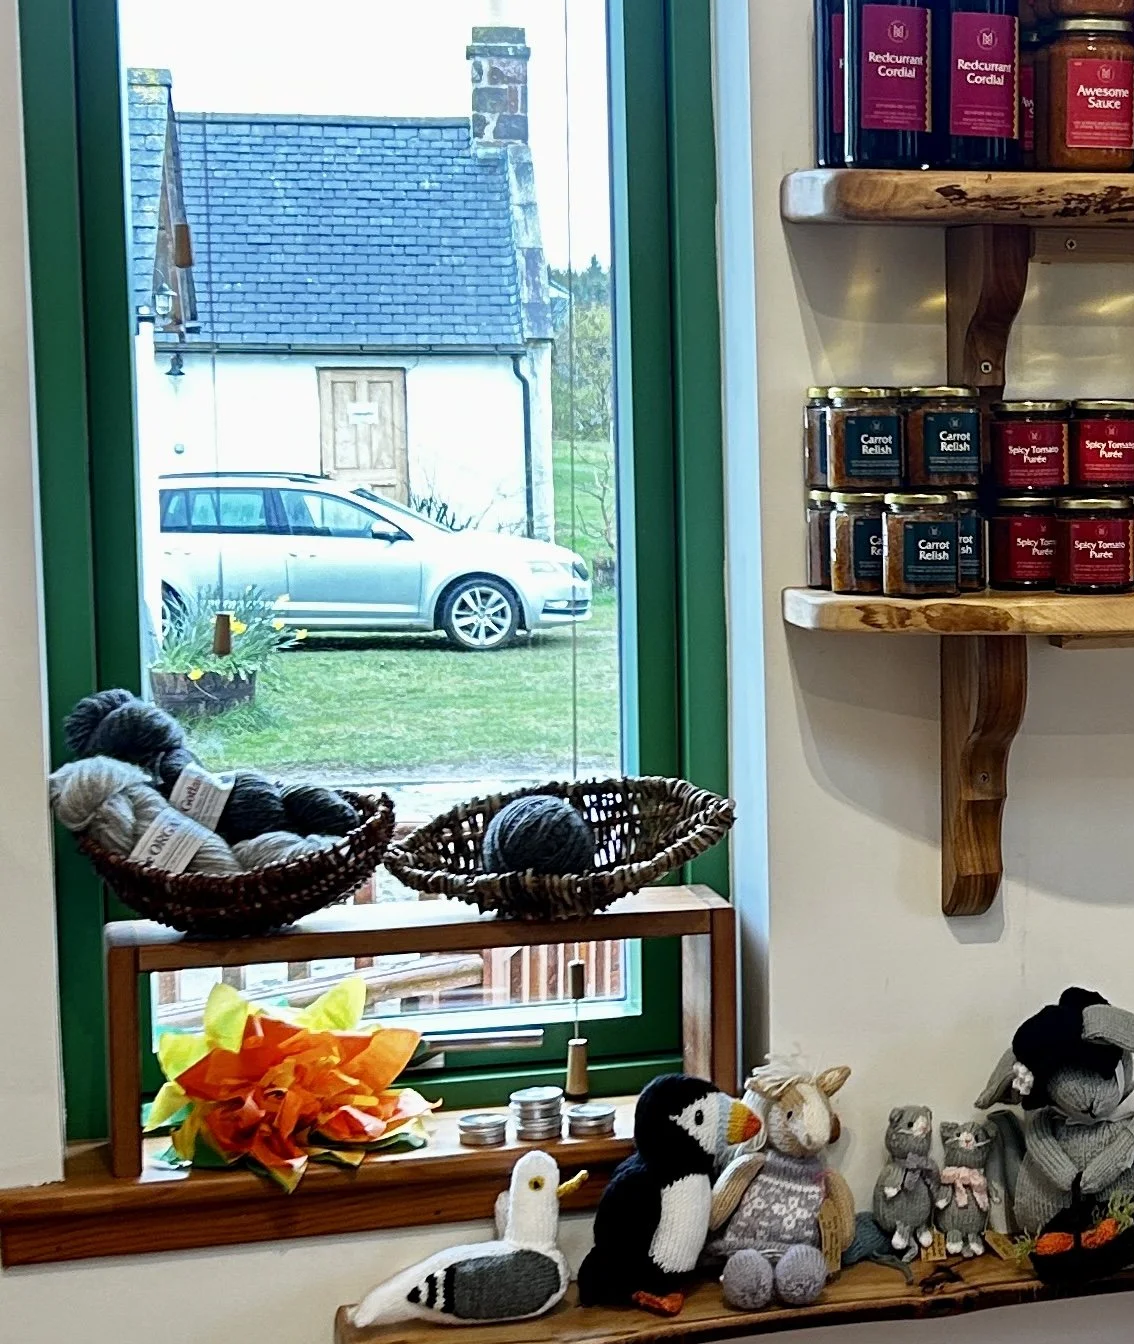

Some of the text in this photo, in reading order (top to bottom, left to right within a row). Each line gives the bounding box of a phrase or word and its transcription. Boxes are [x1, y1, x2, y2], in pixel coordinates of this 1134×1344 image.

[868, 51, 923, 66] Redcurrant
[957, 59, 1012, 73] Redcurrant
[877, 65, 916, 79] Cordial
[966, 72, 1004, 86] Cordial
[1076, 84, 1129, 98] Awesome
[1087, 96, 1121, 110] Sauce
[860, 434, 893, 445] Carrot
[939, 431, 971, 442] Carrot
[861, 444, 892, 455] Relish
[940, 441, 971, 452] Relish
[1008, 445, 1059, 456] Spicy Tomato
[1085, 440, 1107, 451] Spicy
[1023, 453, 1047, 464] Purée
[1099, 449, 1123, 459] Purée
[918, 539, 950, 550] Carrot
[959, 535, 973, 544] rot
[1016, 537, 1038, 548] Spicy
[1074, 540, 1126, 551] Spicy Tomato
[919, 550, 950, 561] Relish
[1089, 549, 1114, 560] Purée
